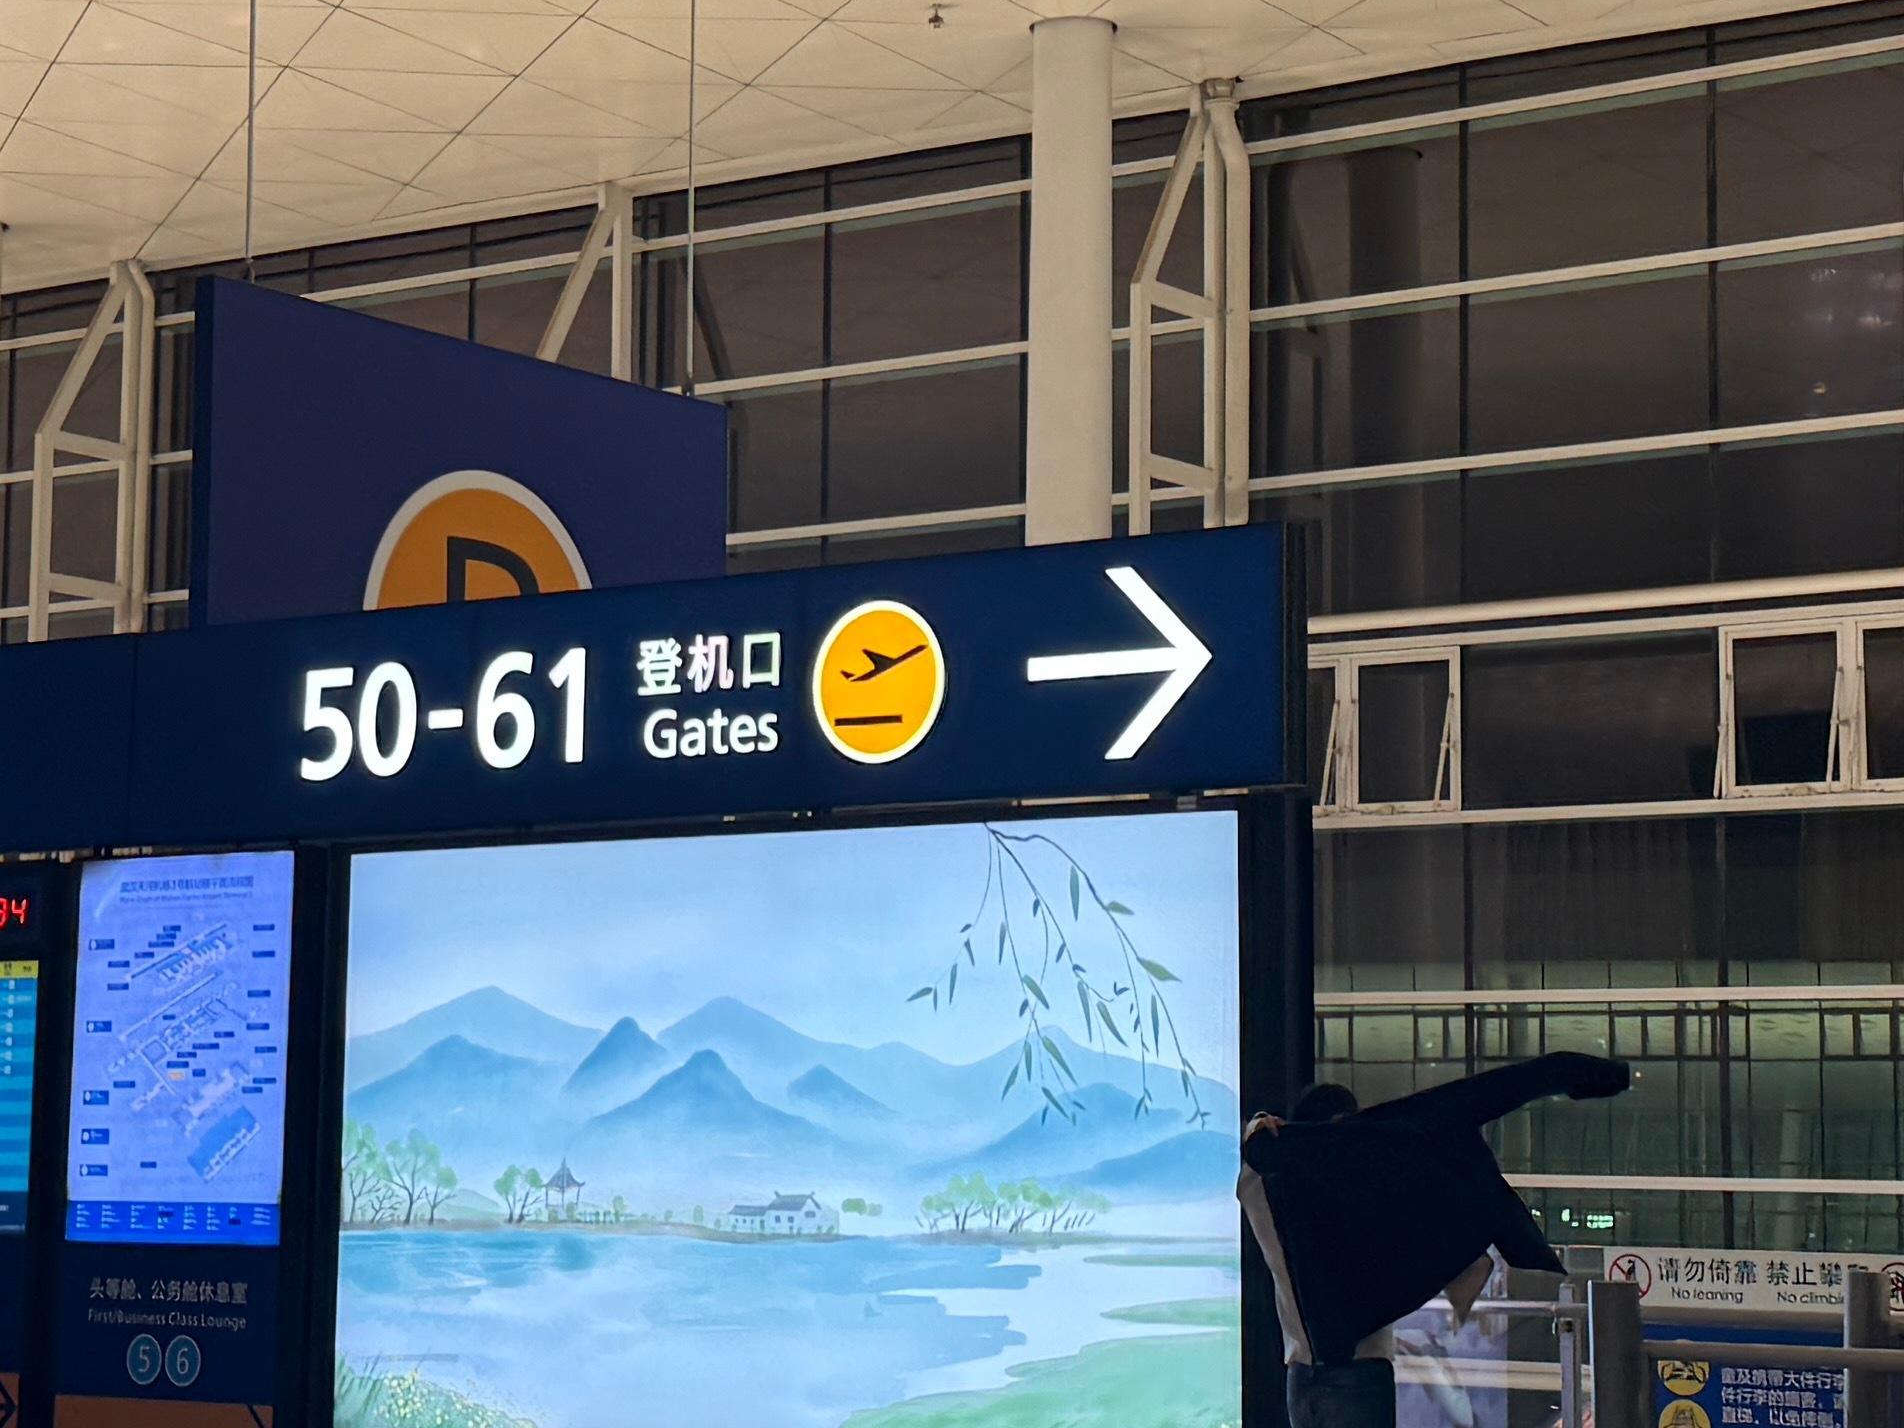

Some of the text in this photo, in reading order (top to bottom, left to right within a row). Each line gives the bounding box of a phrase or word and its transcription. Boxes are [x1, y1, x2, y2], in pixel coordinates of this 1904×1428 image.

[636, 631, 783, 696] 登机口
[299, 646, 587, 781] 50-61
[644, 707, 779, 759] Gates
[1657, 1257, 1757, 1285] 请勿倚靠
[89, 1277, 247, 1304] 头等舱、公务舱休息室
[1671, 1286, 1744, 1303] No leaning
[1777, 1290, 1796, 1303] No
[168, 1312, 198, 1327] Class
[201, 1314, 246, 1332] Lounge
[138, 1346, 189, 1374] 5 6
